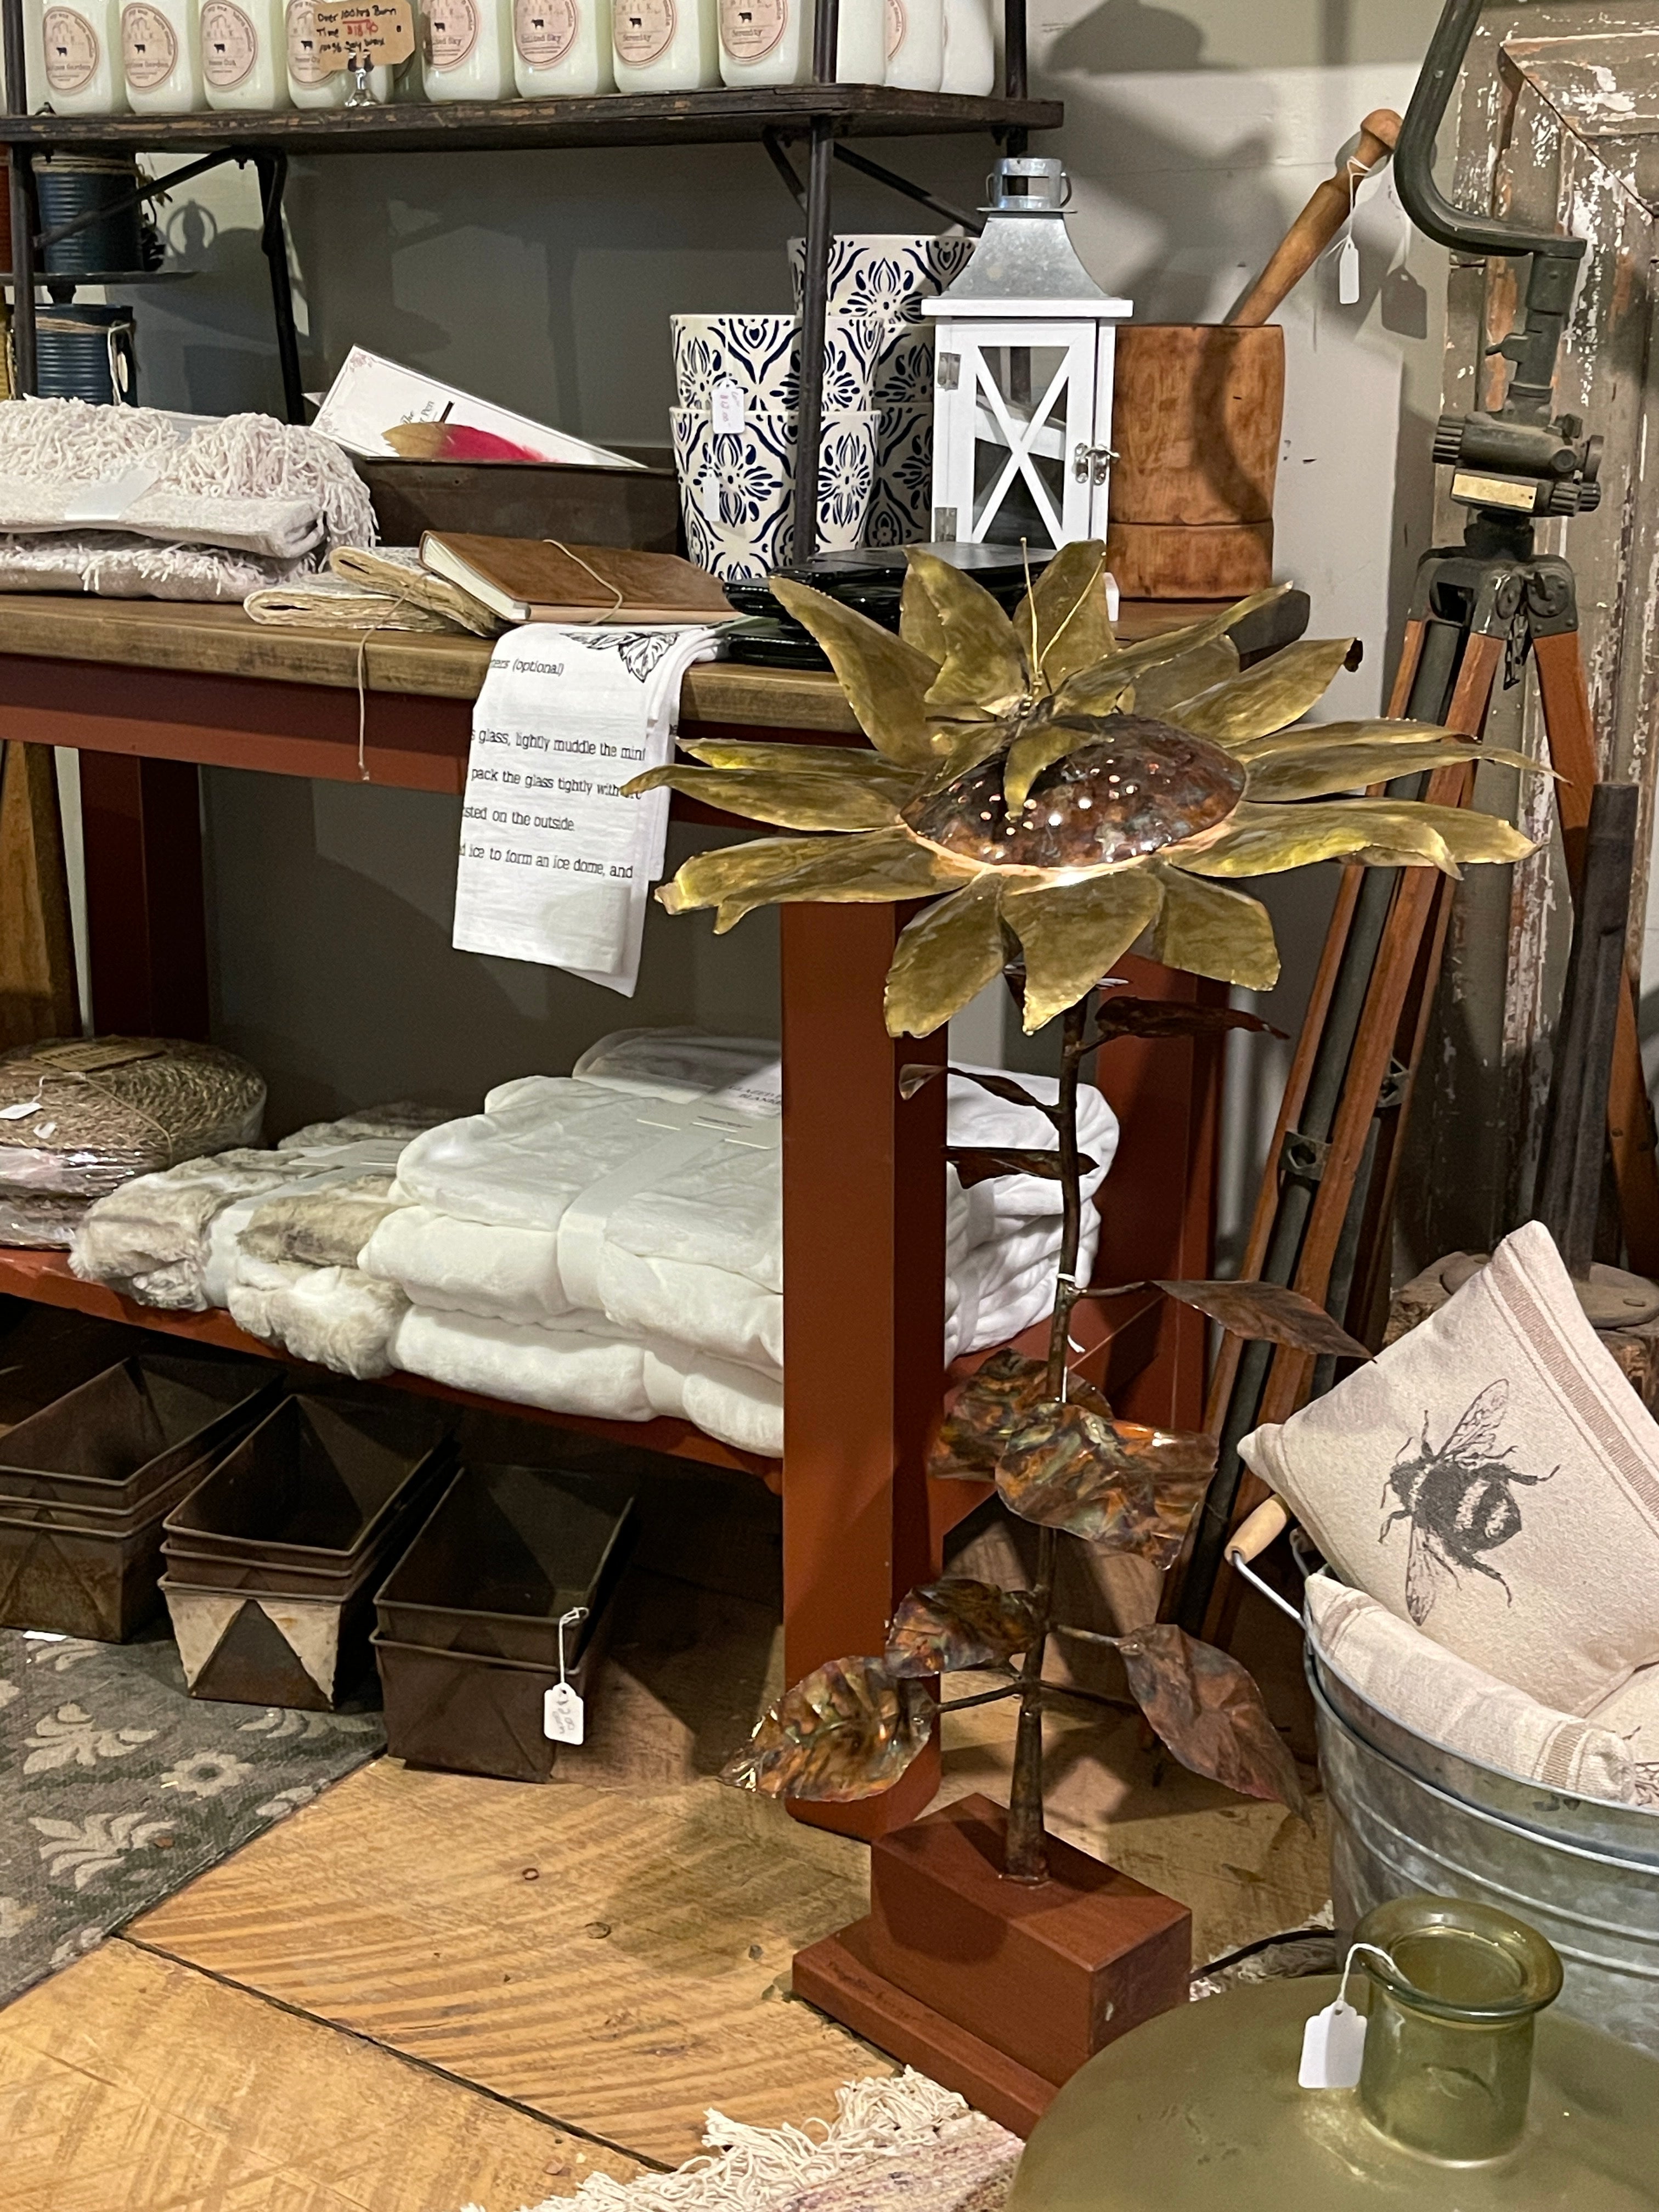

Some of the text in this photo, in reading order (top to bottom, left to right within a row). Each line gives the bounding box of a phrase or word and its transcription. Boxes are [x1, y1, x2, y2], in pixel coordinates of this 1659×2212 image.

[318, 13, 338, 23] Over
[372, 4, 398, 16] Burn
[316, 27, 339, 38] Time
[512, 658, 564, 676] (optional)
[479, 729, 511, 746] glass,
[516, 732, 550, 752] lightly
[553, 740, 596, 755] muddle
[600, 742, 617, 757] the
[471, 768, 499, 782] pack
[503, 771, 521, 785] the
[525, 774, 554, 789] glass
[558, 777, 592, 795] tightly
[597, 782, 619, 797] with
[492, 810, 507, 823] on
[512, 811, 531, 826] the
[469, 844, 485, 859] ice
[490, 848, 501, 861] to
[505, 850, 532, 866] form
[535, 855, 549, 868] an
[552, 855, 569, 870] ice
[573, 859, 605, 877] dome,
[610, 865, 633, 878] and
